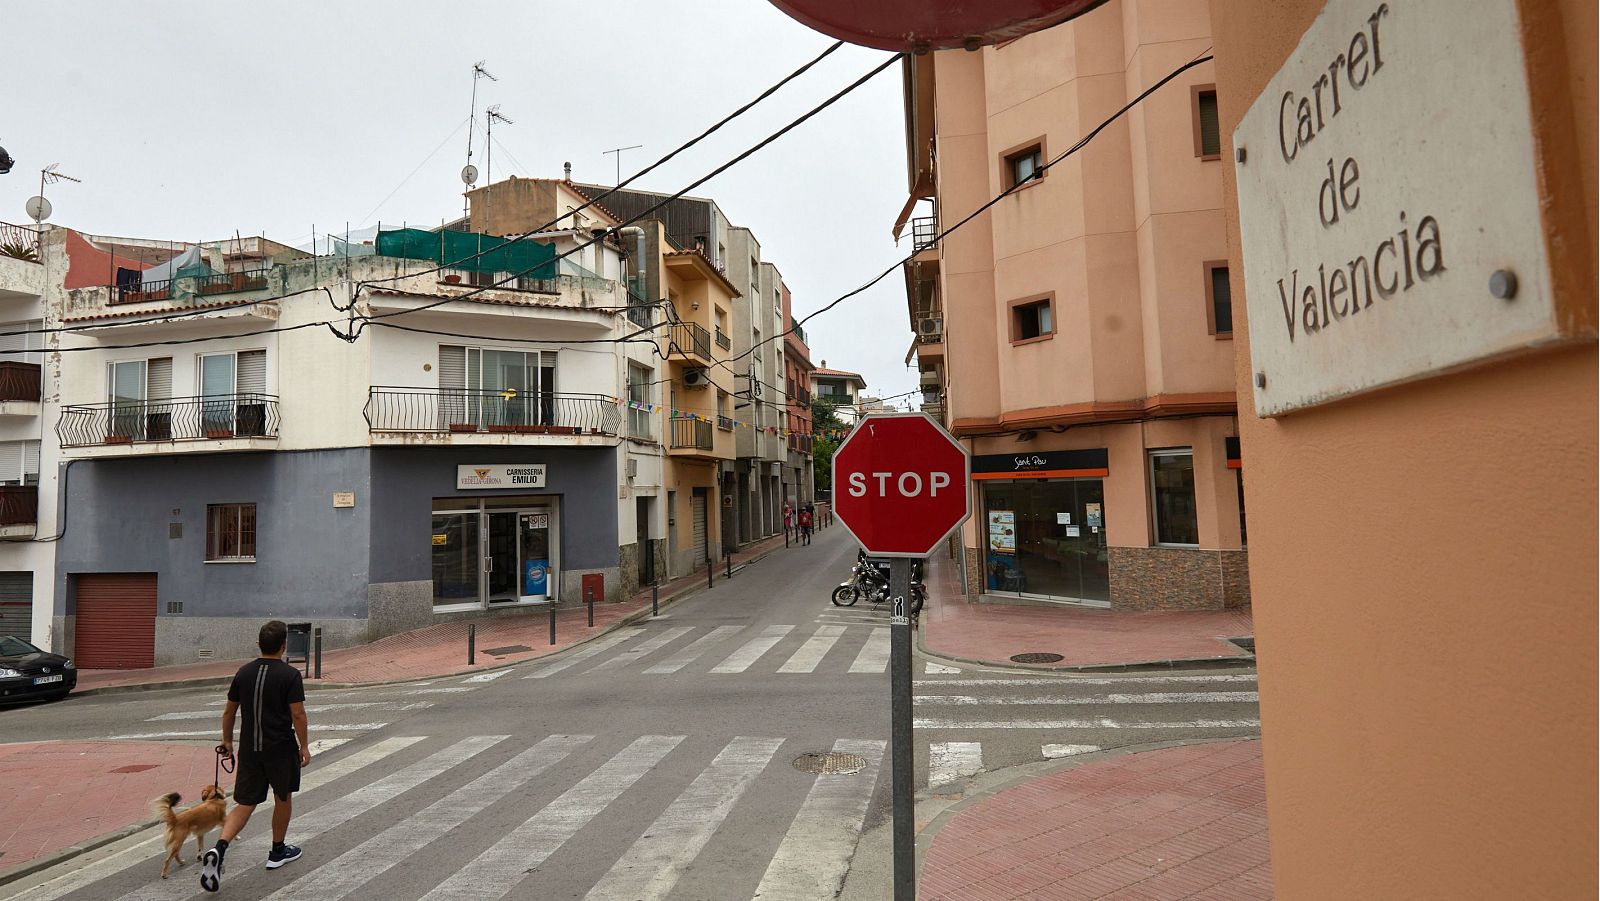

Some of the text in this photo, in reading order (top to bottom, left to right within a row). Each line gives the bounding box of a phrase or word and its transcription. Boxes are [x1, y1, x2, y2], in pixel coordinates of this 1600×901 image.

[1278, 2, 1389, 166] Carrer
[1317, 154, 1361, 229] de
[1276, 210, 1447, 345] Valencia
[506, 468, 543, 476] CARNISSERIA
[1014, 455, 1047, 470] Sant Pau
[511, 475, 537, 484] EMILIO
[848, 471, 951, 498] STOP
